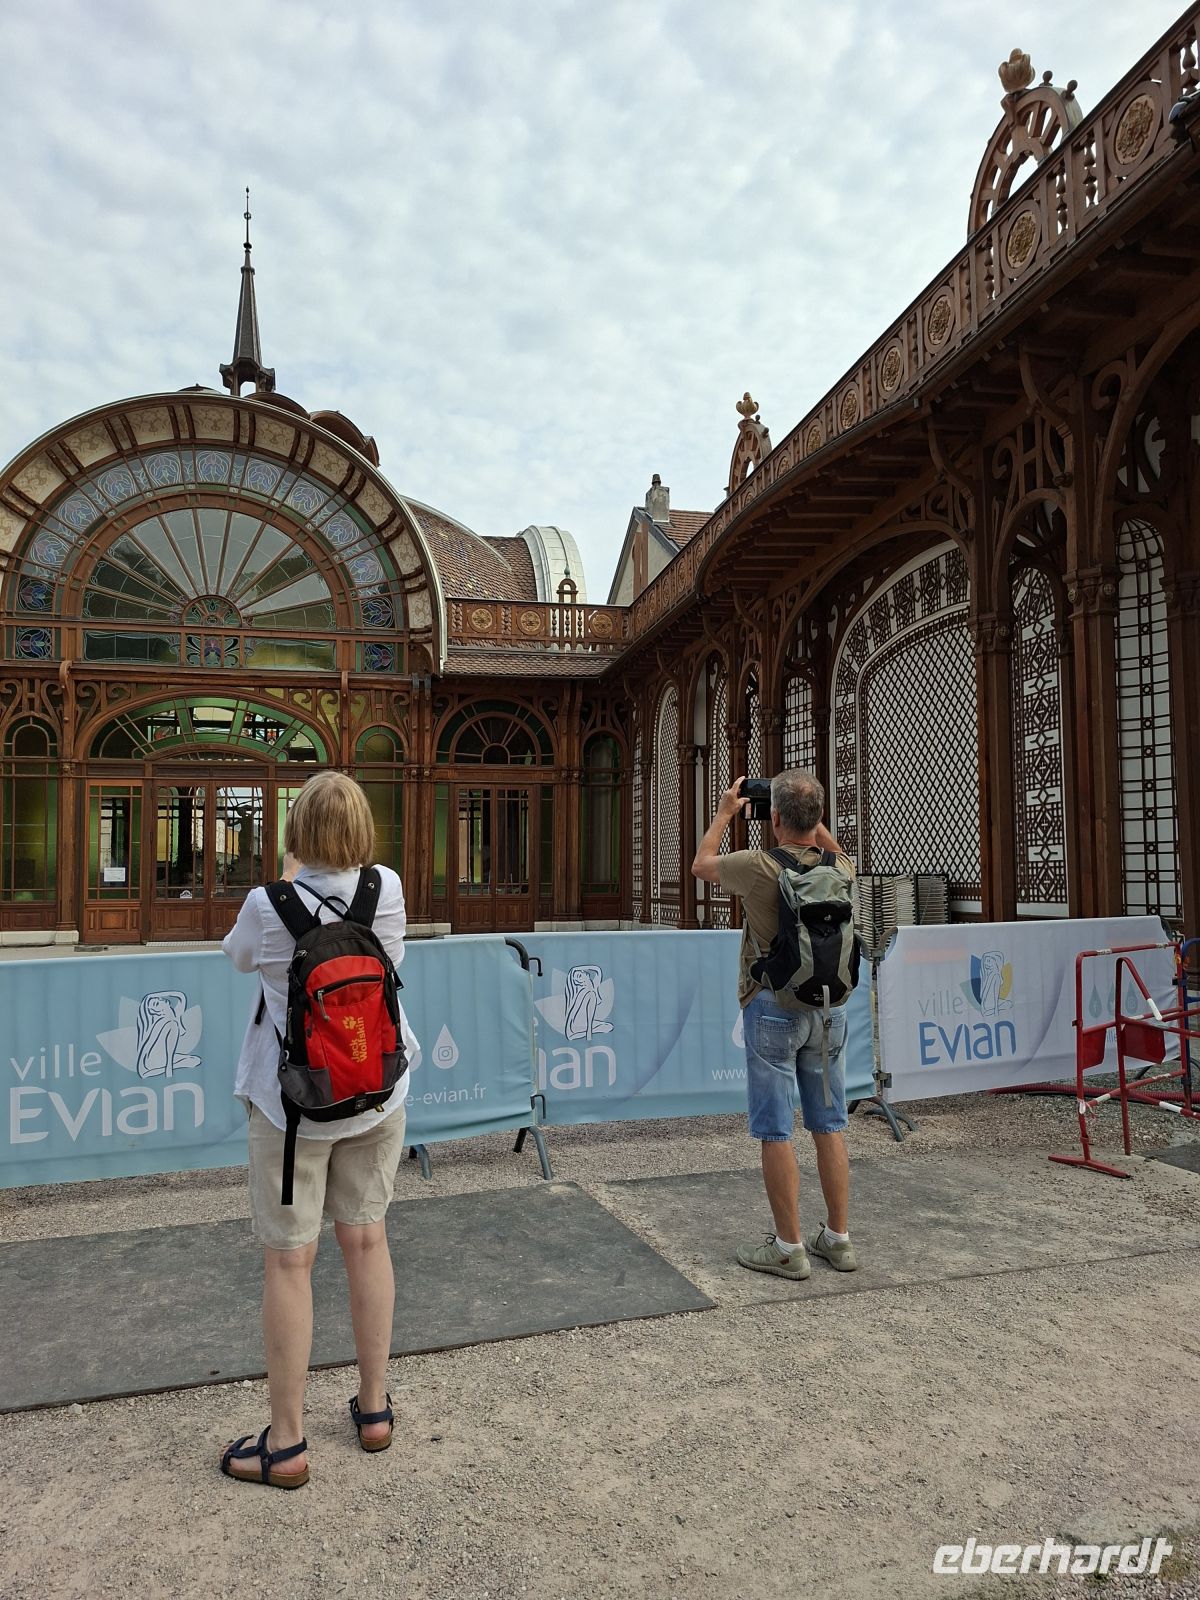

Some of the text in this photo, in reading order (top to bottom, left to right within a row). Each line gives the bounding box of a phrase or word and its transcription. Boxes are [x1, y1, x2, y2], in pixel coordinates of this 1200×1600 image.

[918, 990, 963, 1016] ville
[9, 1043, 102, 1081] ville
[350, 1038, 360, 1062] Jack
[919, 1020, 1017, 1065] Evian
[535, 1045, 617, 1090] ian
[9, 1082, 205, 1144] Evian
